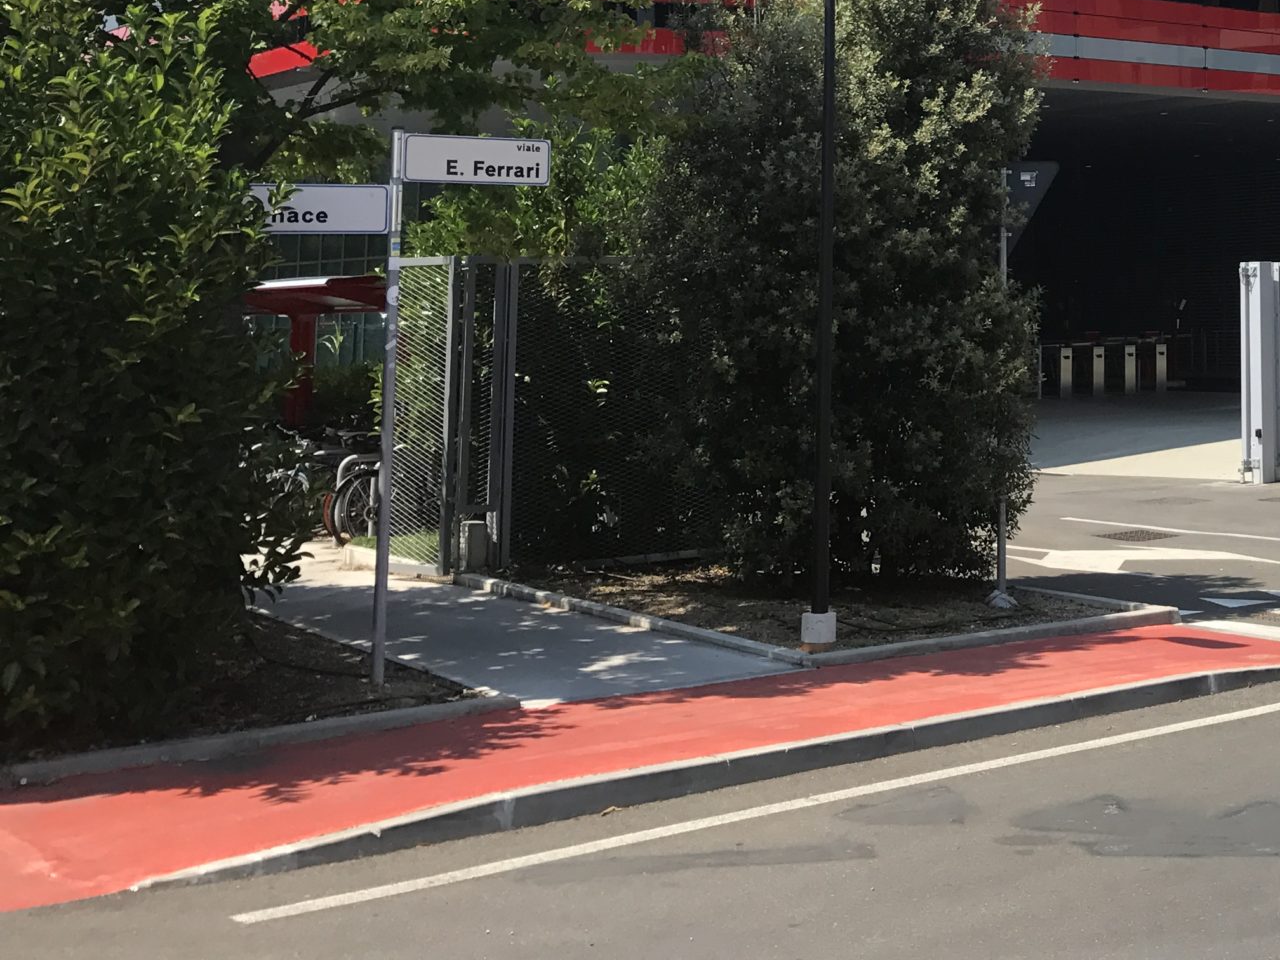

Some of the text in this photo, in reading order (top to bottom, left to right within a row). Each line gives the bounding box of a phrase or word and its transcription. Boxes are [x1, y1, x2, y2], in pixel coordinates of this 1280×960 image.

[516, 143, 541, 153] viale
[446, 159, 540, 179] E. Ferrari
[270, 209, 329, 224] nace
